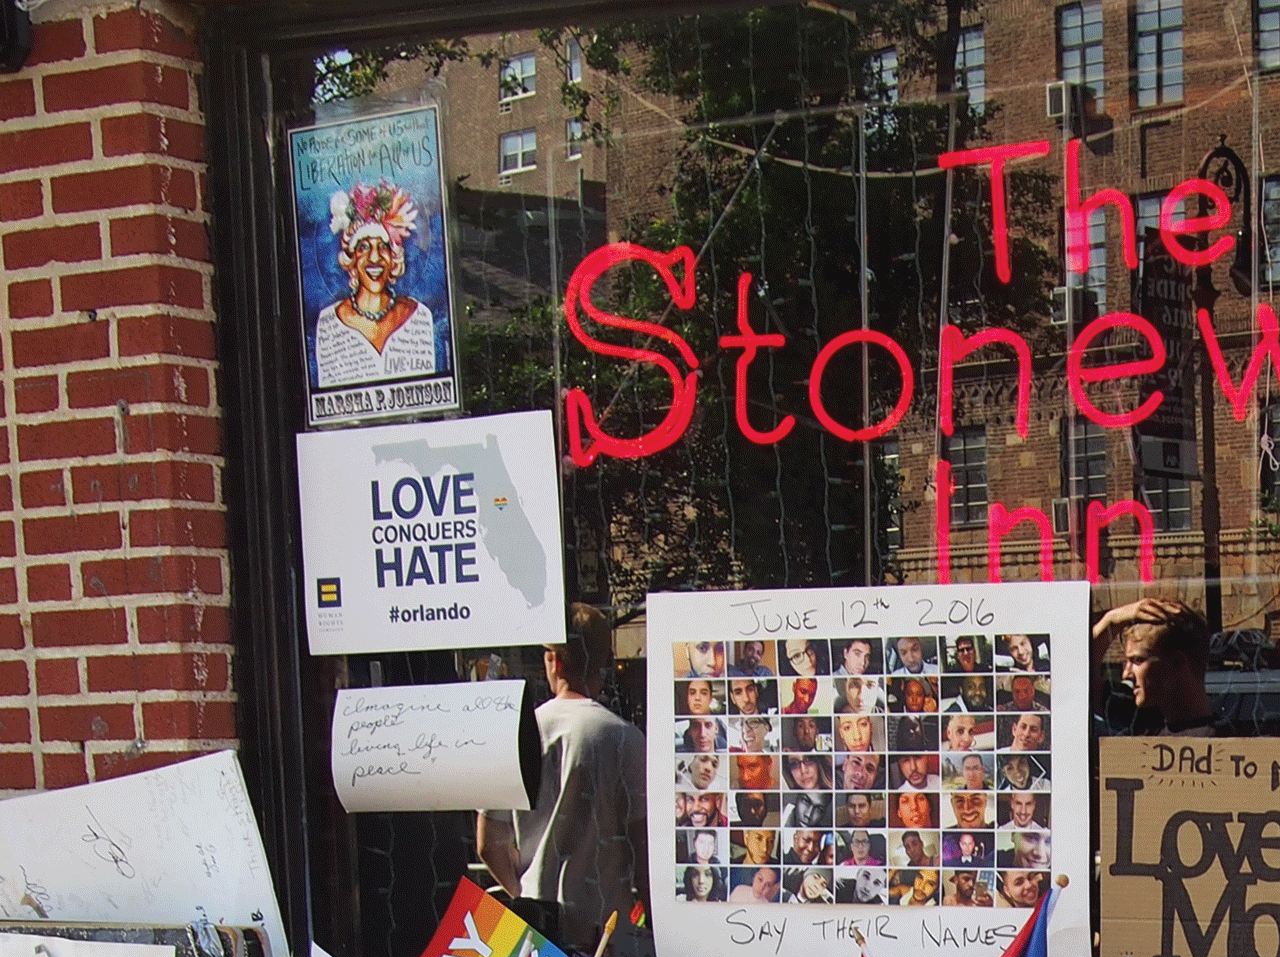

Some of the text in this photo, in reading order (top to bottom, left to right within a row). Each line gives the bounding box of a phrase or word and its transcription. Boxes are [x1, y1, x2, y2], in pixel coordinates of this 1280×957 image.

[938, 137, 1235, 284] The
[314, 391, 374, 418] MARSHA
[388, 380, 452, 409] JOHNSON
[371, 473, 477, 521] LOVE
[371, 519, 477, 545] CONQUERS
[934, 459, 1157, 586] Inn
[375, 542, 480, 588] HATE
[389, 601, 471, 624] #orlando
[729, 597, 819, 635] JUNE
[915, 597, 996, 628] 2016
[726, 908, 1019, 956] SAY THEIR NAMES
